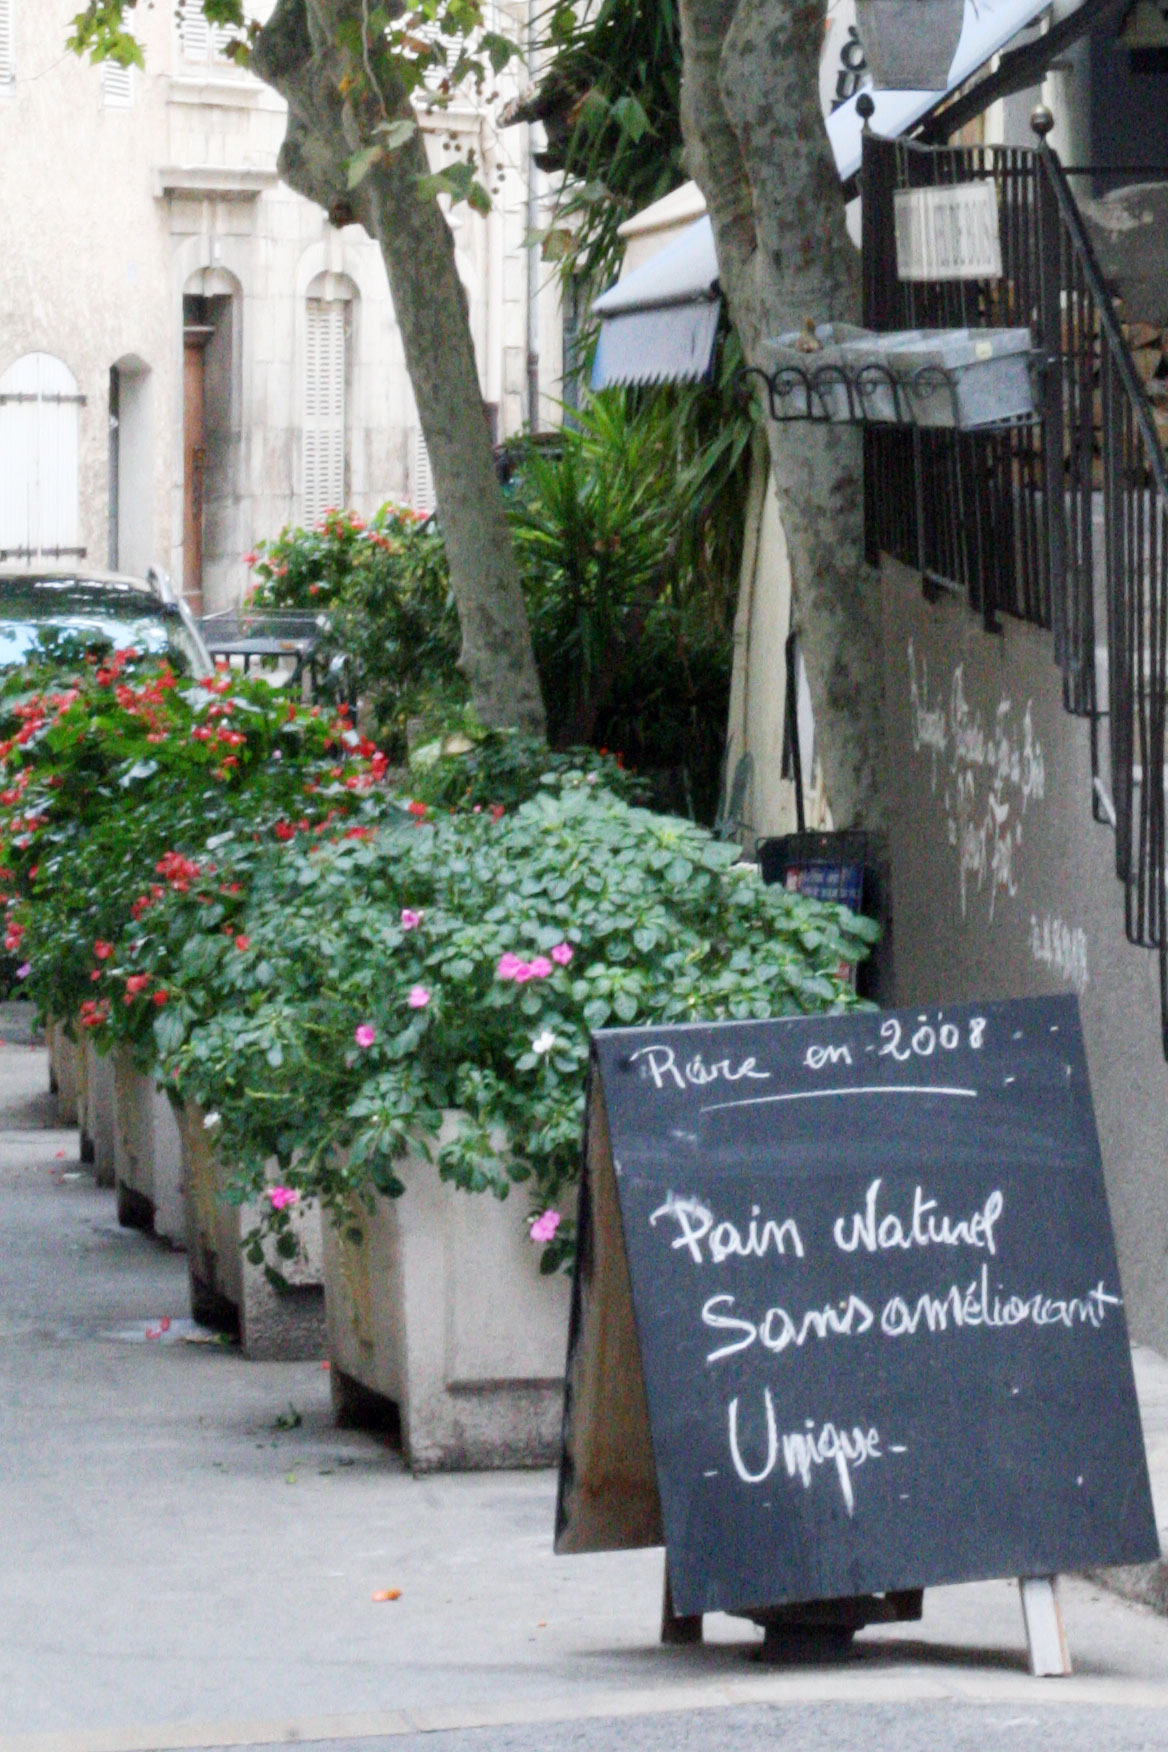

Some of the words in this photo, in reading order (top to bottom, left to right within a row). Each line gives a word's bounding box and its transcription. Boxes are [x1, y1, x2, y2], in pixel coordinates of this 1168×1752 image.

[803, 1045, 852, 1070] en
[878, 1014, 988, 1061] 2008
[650, 1193, 804, 1263] Pain
[702, 1294, 874, 1362] Sans
[728, 1387, 882, 1518] Unique
